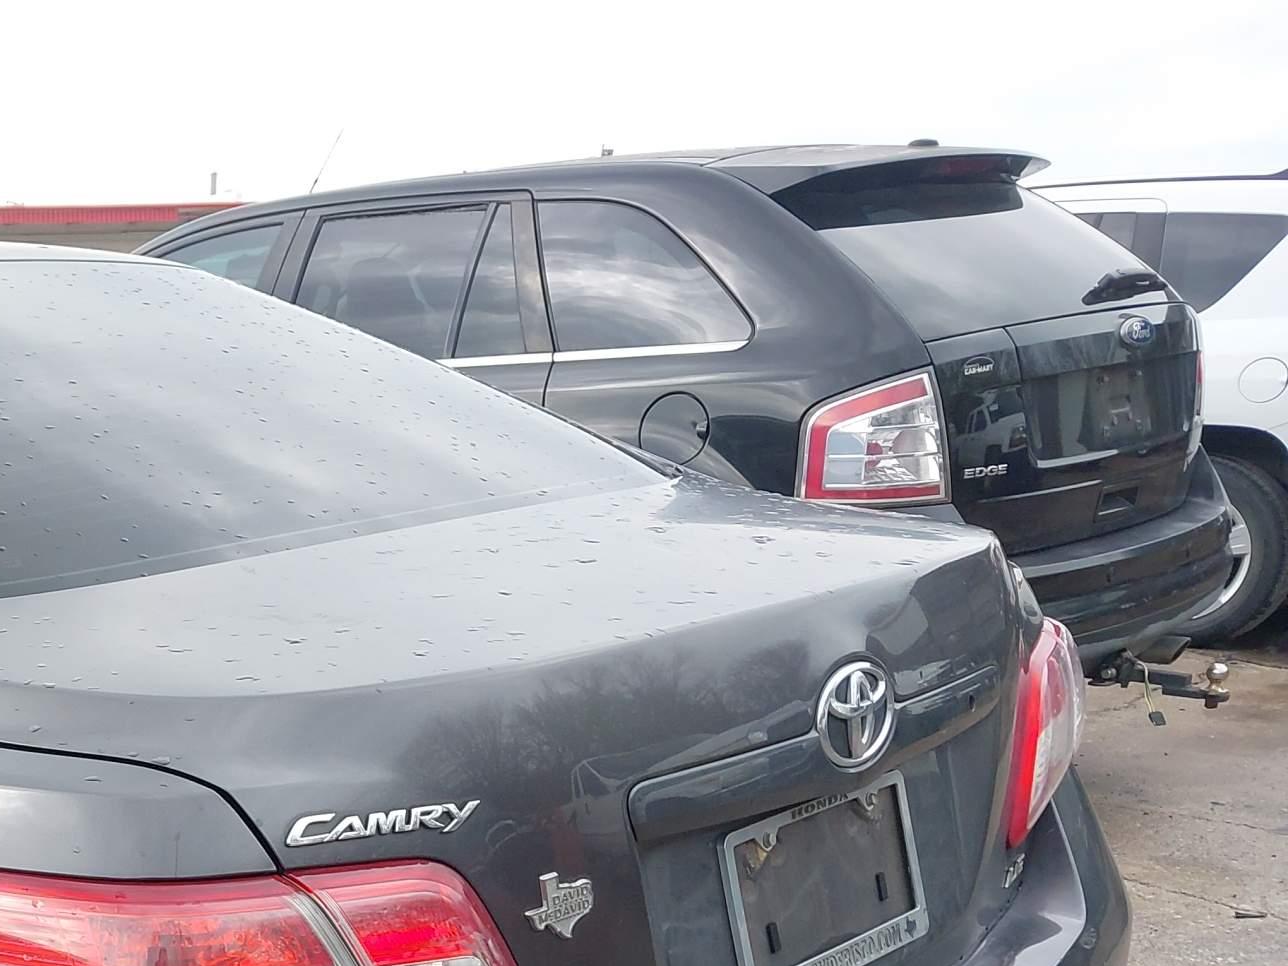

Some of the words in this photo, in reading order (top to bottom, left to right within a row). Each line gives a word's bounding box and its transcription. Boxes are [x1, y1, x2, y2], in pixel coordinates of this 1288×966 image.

[963, 464, 1009, 480] EDGE
[791, 793, 849, 820] HONDA
[285, 799, 482, 848] CAMRY
[552, 885, 590, 906] DAVID
